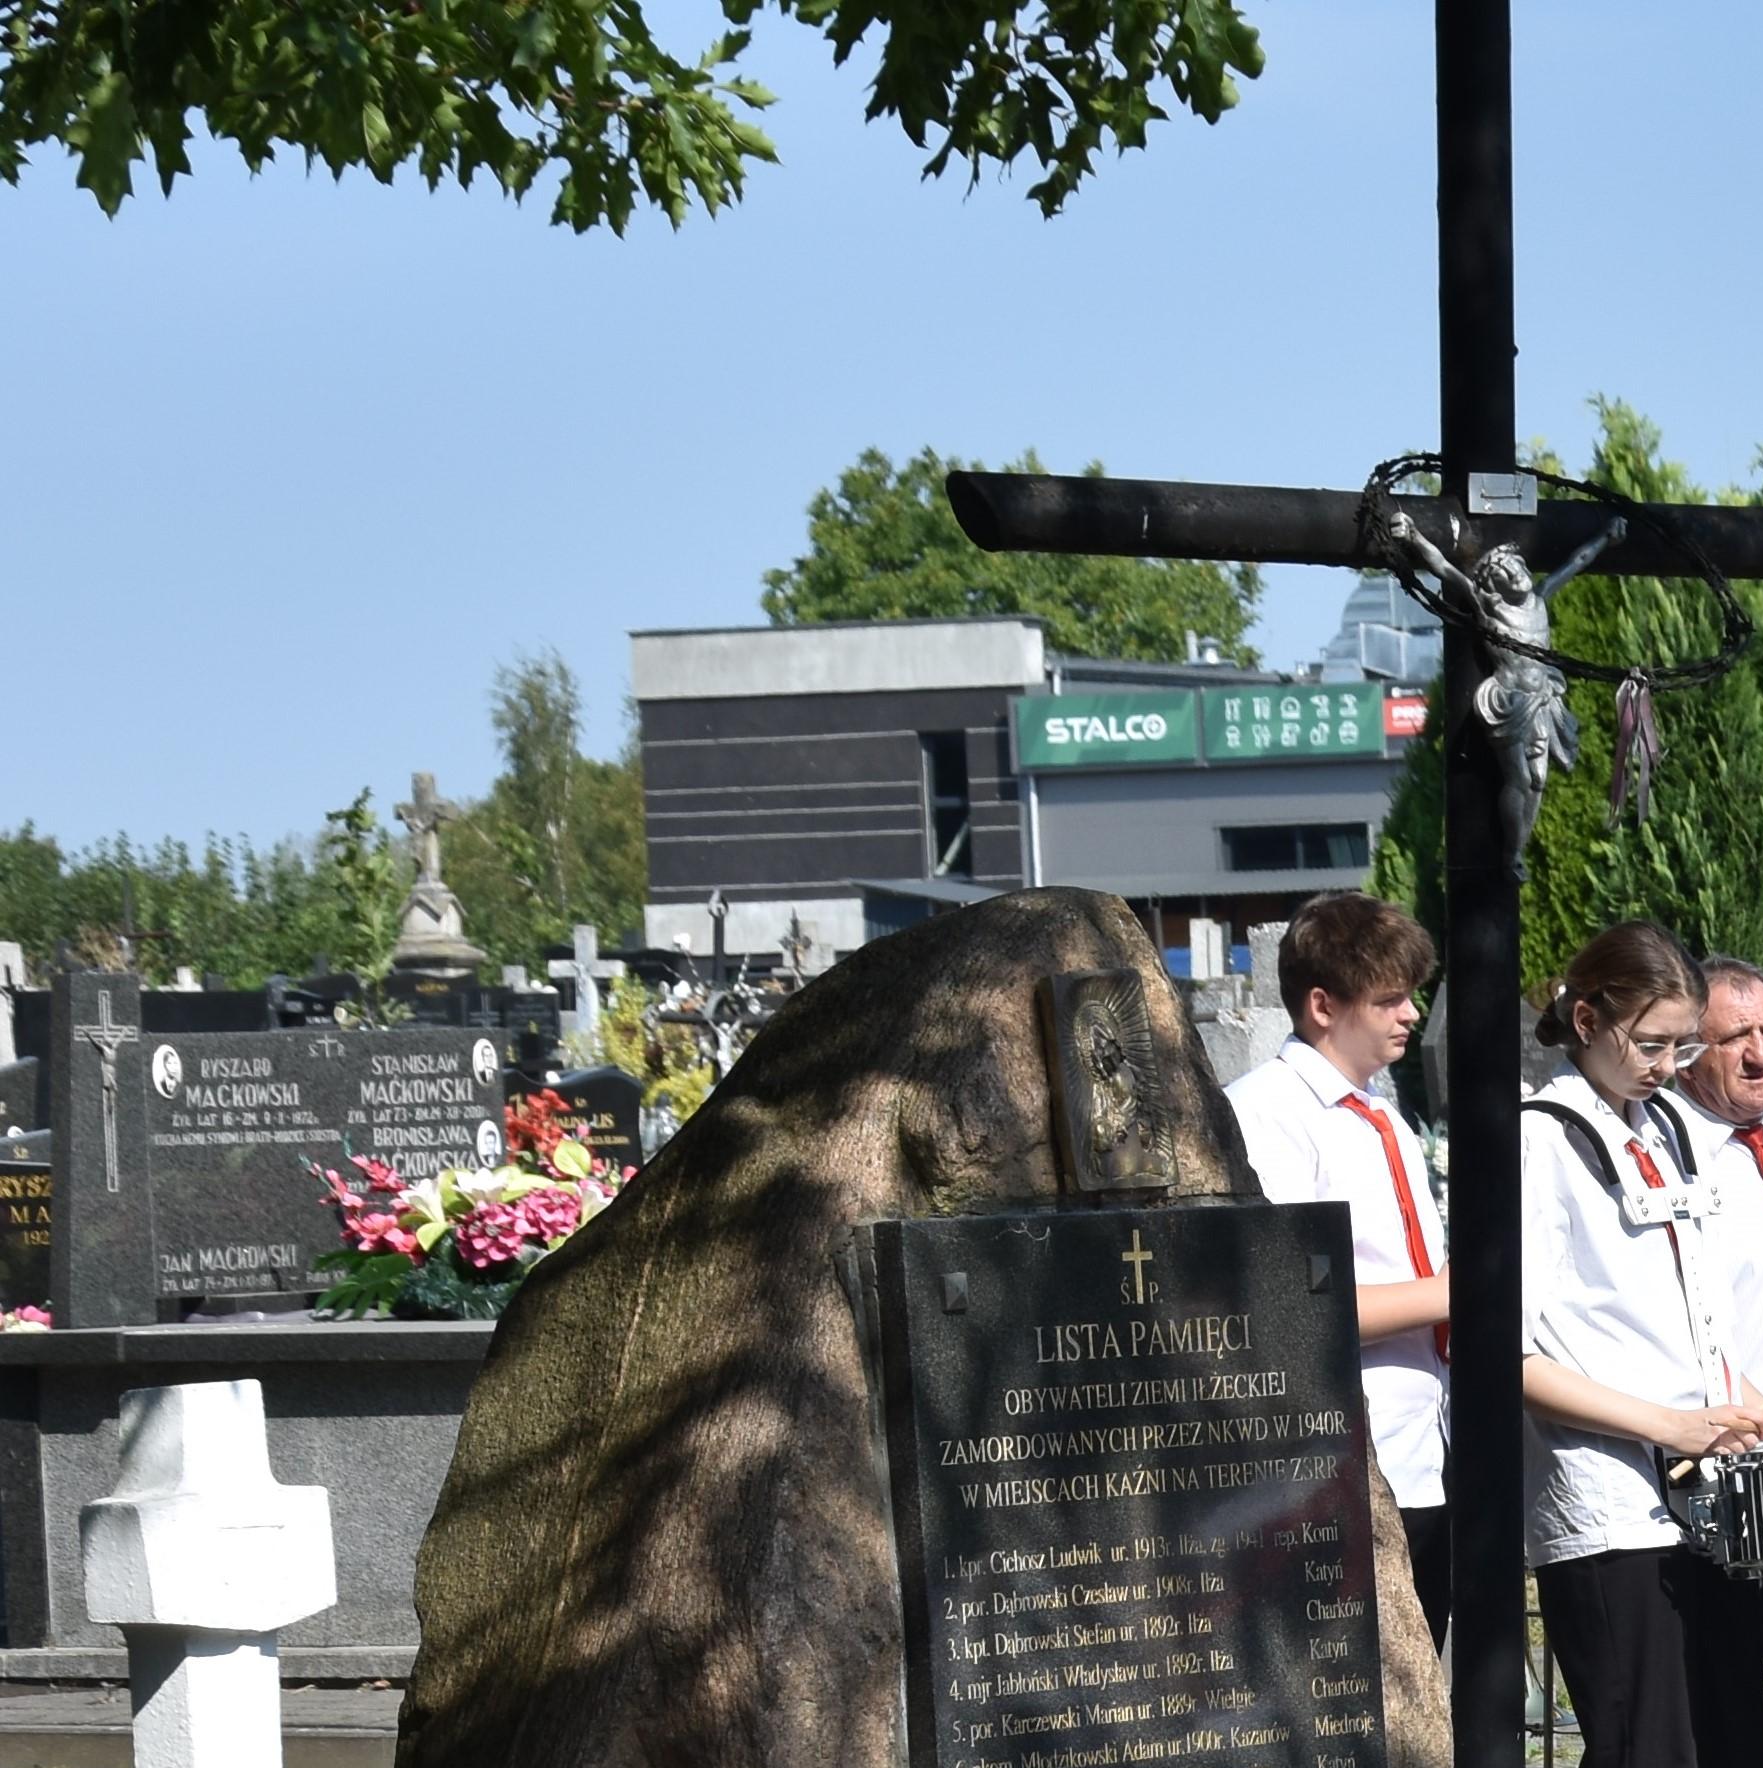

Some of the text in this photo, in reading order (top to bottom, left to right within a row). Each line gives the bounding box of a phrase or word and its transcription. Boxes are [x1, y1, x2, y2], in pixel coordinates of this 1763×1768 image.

[1045, 713, 1167, 744] STALCO
[201, 1058, 271, 1077] RYSZARD
[160, 1254, 192, 1273] JAN
[1034, 1312, 1253, 1364] LISTA PAMIĘCI
[1003, 1367, 1287, 1416] OBYWATELI ZIEMI IŁŻECKIEJ
[938, 1409, 1351, 1466] ZAMORDOWANYCH PRZEZ NKWD W 1940R.
[959, 1454, 1338, 1510] W MIEJSCACH KAŹNI NA TERENIE ZSRR
[943, 1556, 955, 1578] 1.
[958, 1552, 986, 1583] kpr.
[989, 1547, 1046, 1574] Cichosz
[1049, 1541, 1103, 1568] Ludwik
[1110, 1545, 1129, 1562] ur.
[1133, 1534, 1174, 1560] 1913r.
[1273, 1528, 1298, 1552] rep.
[1301, 1519, 1339, 1544] Komi
[943, 1596, 958, 1620] 2.
[961, 1598, 989, 1624] por.
[992, 1584, 1068, 1619] Dąbrowski
[1071, 1578, 1129, 1607] Czesław
[1132, 1583, 1151, 1601] ur.
[1155, 1572, 1196, 1598] 1908r.
[1304, 1557, 1344, 1588] Katyń
[946, 1637, 960, 1661] 3.
[963, 1634, 990, 1665] kpt.
[994, 1624, 1070, 1660] Dąbrowski
[1072, 1620, 1116, 1647] Stefan
[1119, 1625, 1137, 1642] ur.
[1143, 1613, 1183, 1639] 1892r.
[1306, 1594, 1366, 1622] Charków
[948, 1679, 963, 1702] 4.
[967, 1674, 993, 1705] mjr
[996, 1667, 1059, 1697] Jabłoński
[1063, 1658, 1139, 1694] Władysław
[1142, 1662, 1161, 1680] ur.
[1165, 1651, 1205, 1677] 1892r.
[1309, 1635, 1348, 1665] Katyń
[951, 1670, 1370, 1747] 5. por. Karczewski Marian ur. 1889r. Wielgie Charków
[1121, 1734, 1165, 1762] Adam
[1229, 1719, 1290, 1749] Kazanów
[1313, 1709, 1376, 1743] Miednoje
